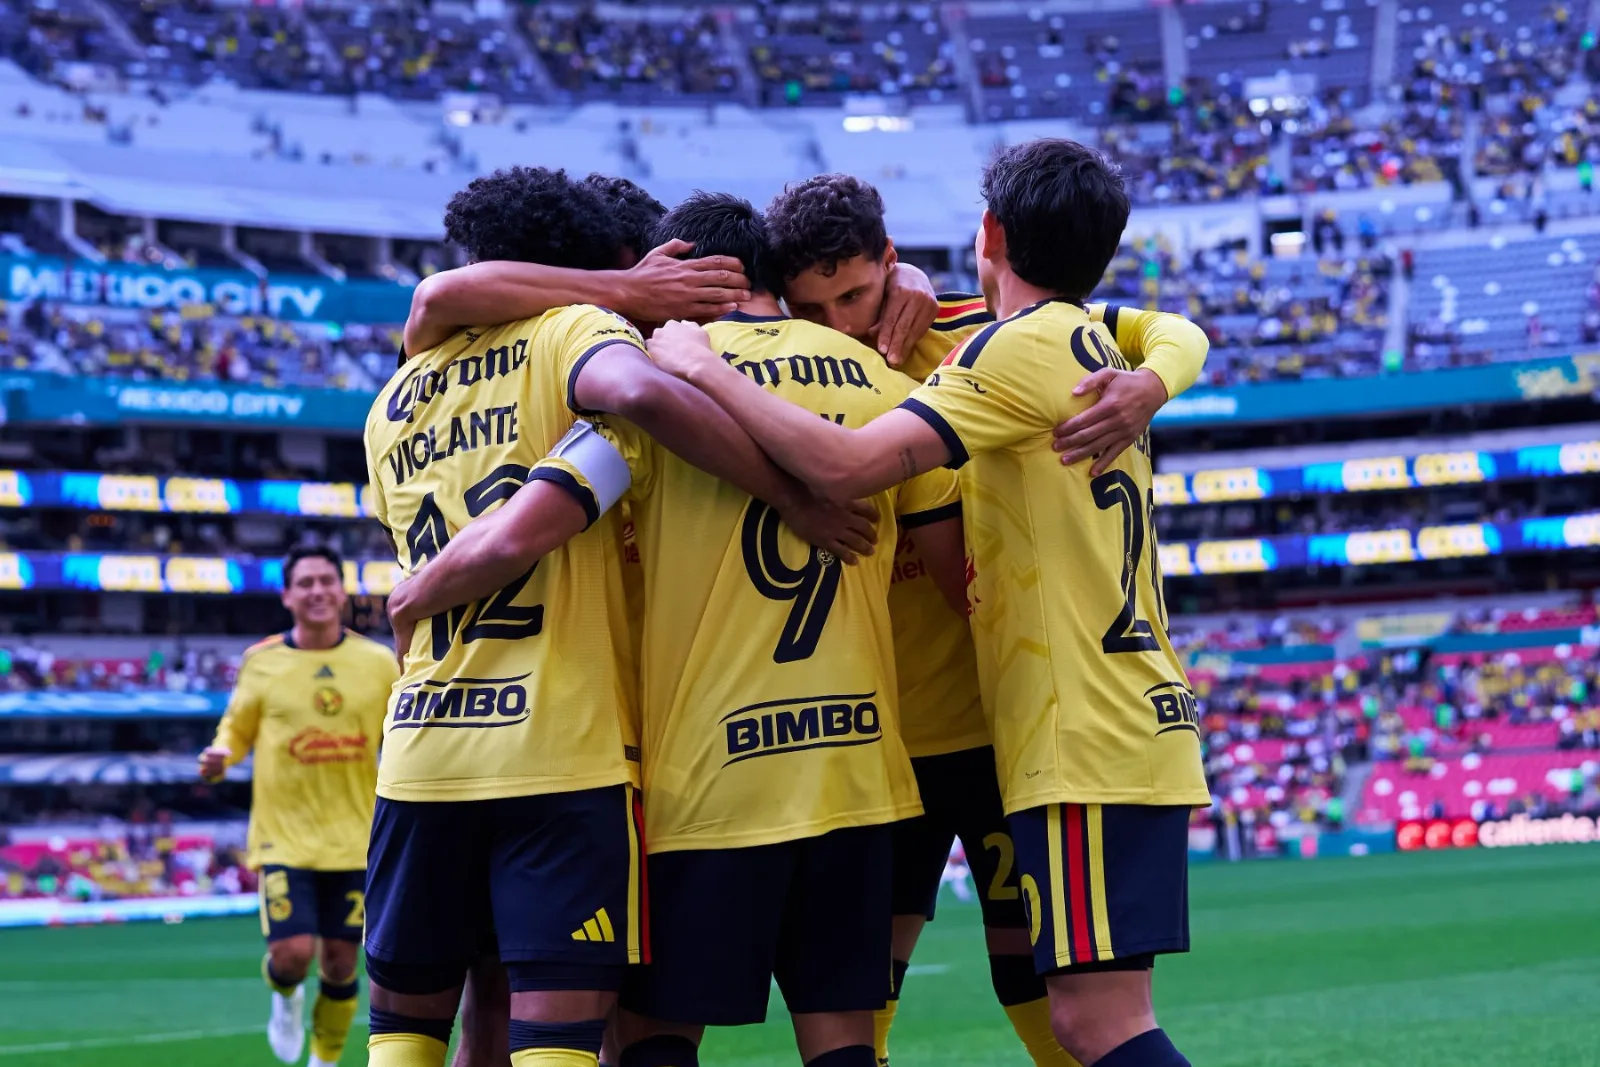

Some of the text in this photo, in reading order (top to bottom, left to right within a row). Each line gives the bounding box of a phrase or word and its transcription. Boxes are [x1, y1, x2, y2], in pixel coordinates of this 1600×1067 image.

[9, 265, 324, 317] MEXICO CITY
[387, 338, 529, 424] Corona
[719, 351, 874, 390] orona
[388, 402, 518, 485] VIOLANTE
[406, 463, 544, 662] 12
[741, 497, 843, 664] 9
[393, 684, 527, 722] BIMBO
[726, 701, 880, 755] BIMBO
